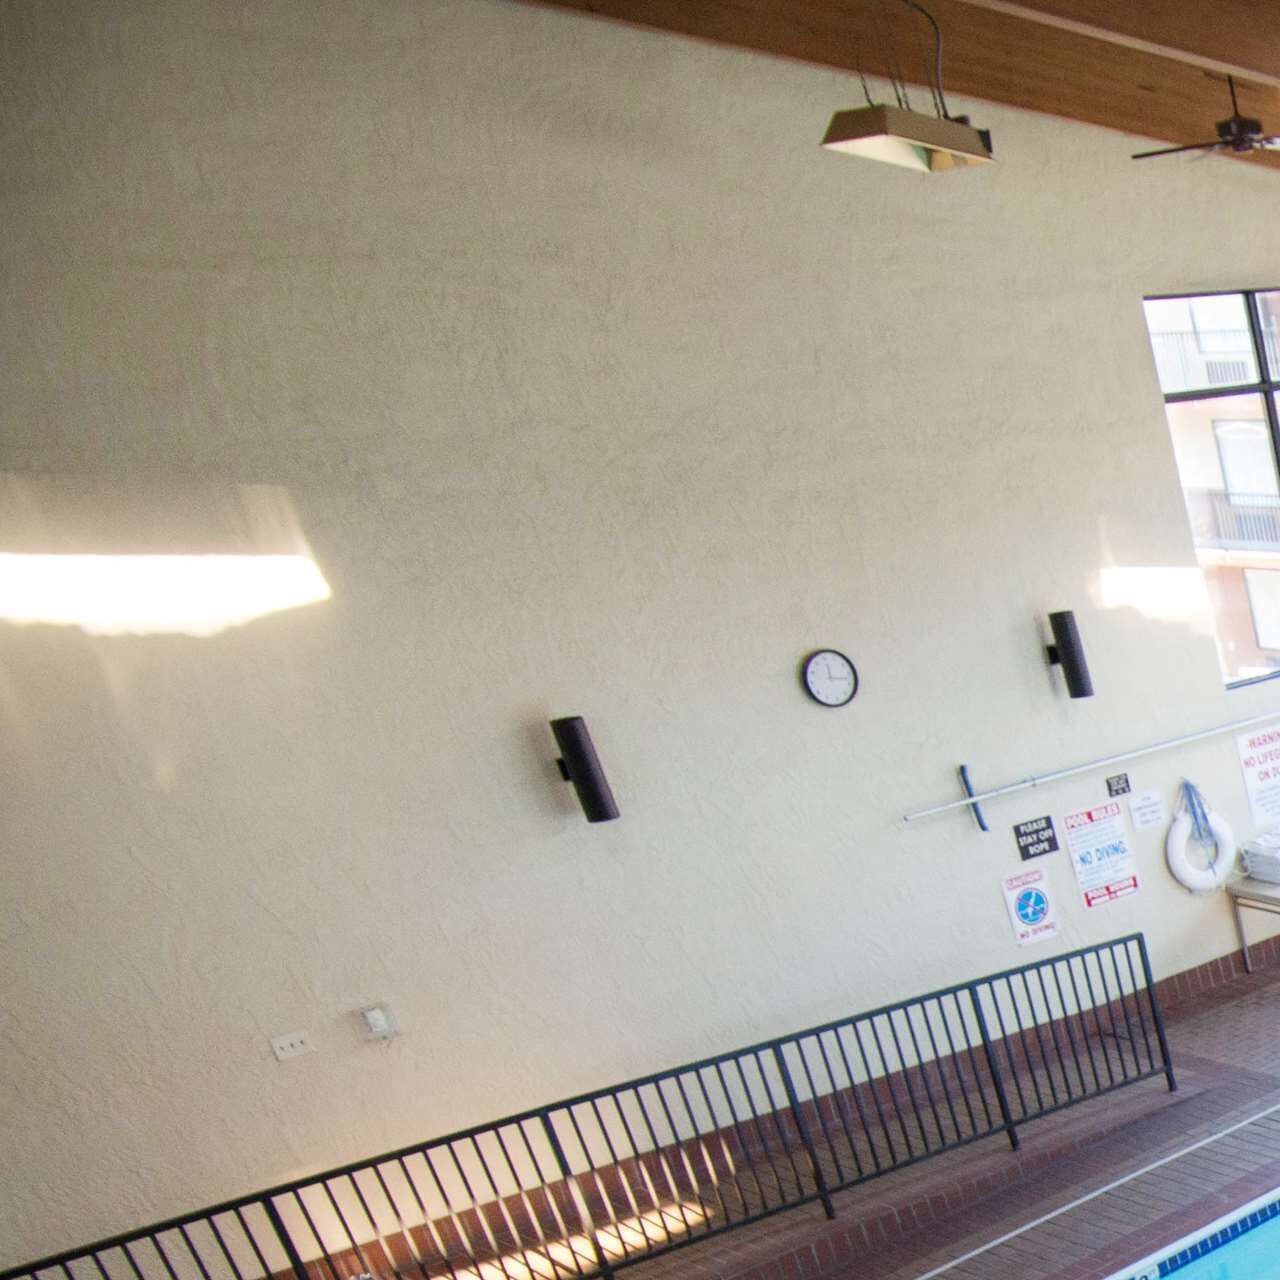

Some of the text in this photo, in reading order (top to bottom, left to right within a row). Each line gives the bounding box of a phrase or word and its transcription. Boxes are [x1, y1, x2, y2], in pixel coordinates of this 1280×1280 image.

[1243, 756, 1256, 769] NO
[1258, 769, 1272, 782] ON
[1020, 818, 1047, 834] PLEASE
[1018, 829, 1054, 847] STAY OFF
[1028, 842, 1051, 855] ROPE
[1079, 850, 1092, 865] NO
